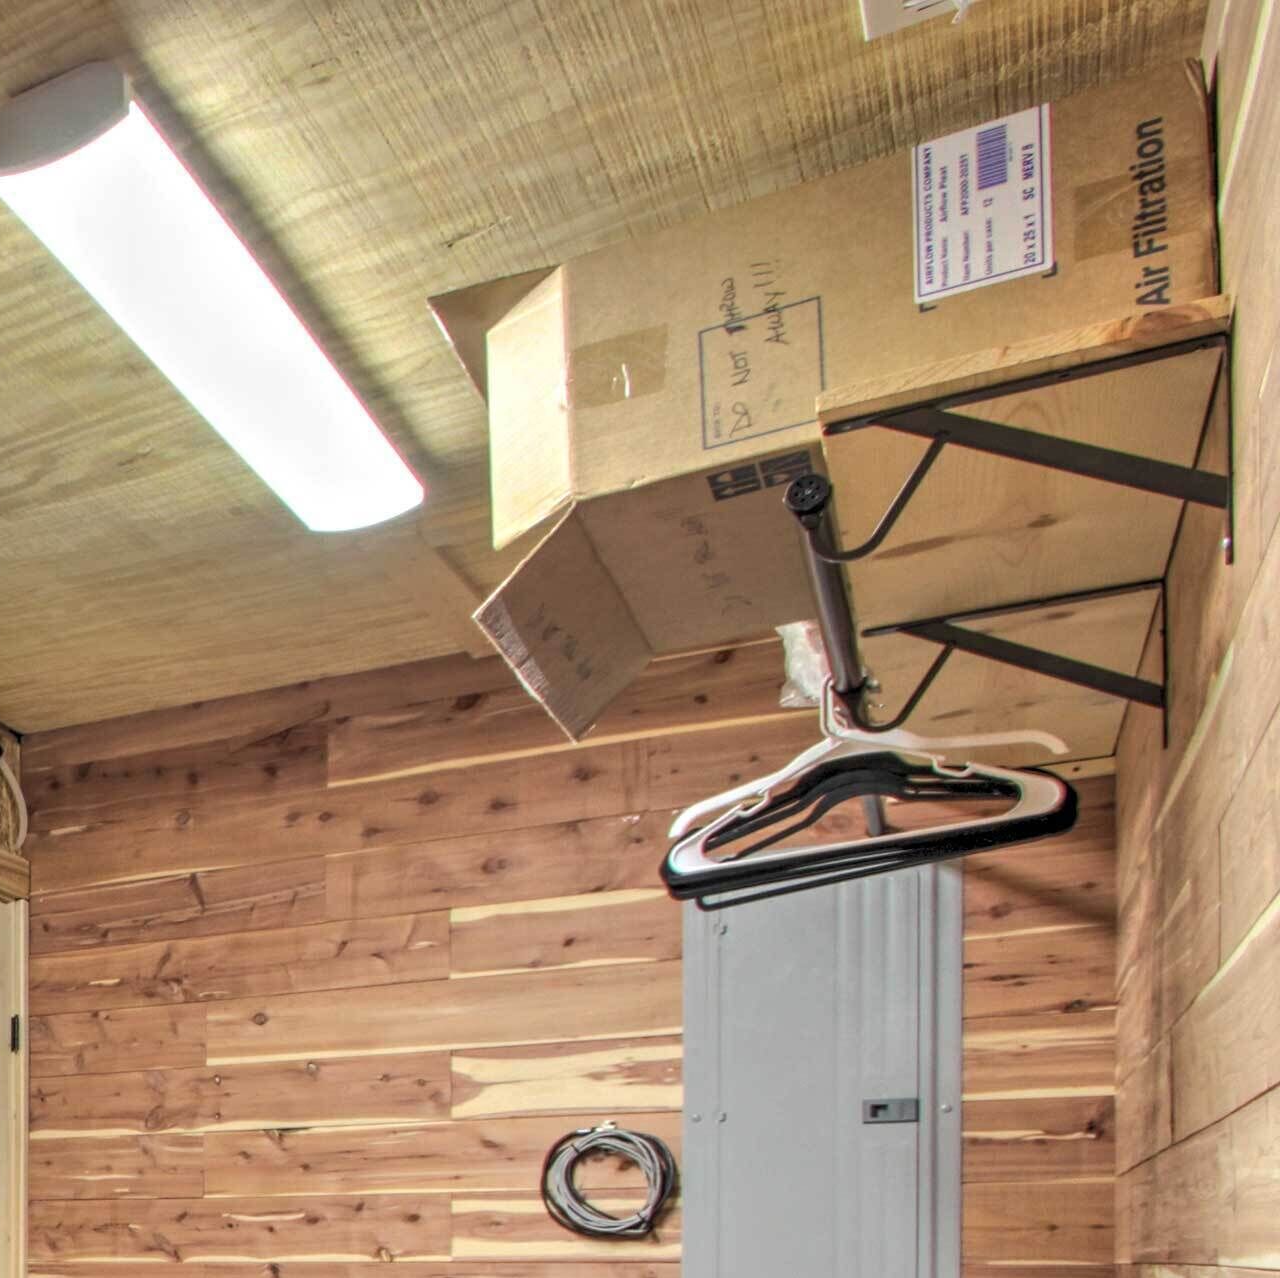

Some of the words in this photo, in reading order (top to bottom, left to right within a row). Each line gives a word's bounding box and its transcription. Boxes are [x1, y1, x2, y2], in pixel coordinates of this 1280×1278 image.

[923, 146, 933, 191] COMPANY
[938, 165, 948, 190] Pleat
[1022, 152, 1035, 180] MERV
[983, 197, 993, 208] 12
[1022, 187, 1035, 201] SC
[1129, 116, 1169, 259] Filtration
[924, 193, 934, 243] PRODUCTS
[939, 191, 948, 224] Airflow
[1023, 229, 1036, 241] 25
[925, 244, 934, 286] AIRFLOW
[1024, 252, 1037, 264] 20
[1135, 266, 1171, 305] Air
[729, 351, 751, 387] NOT
[729, 400, 753, 438] DO
